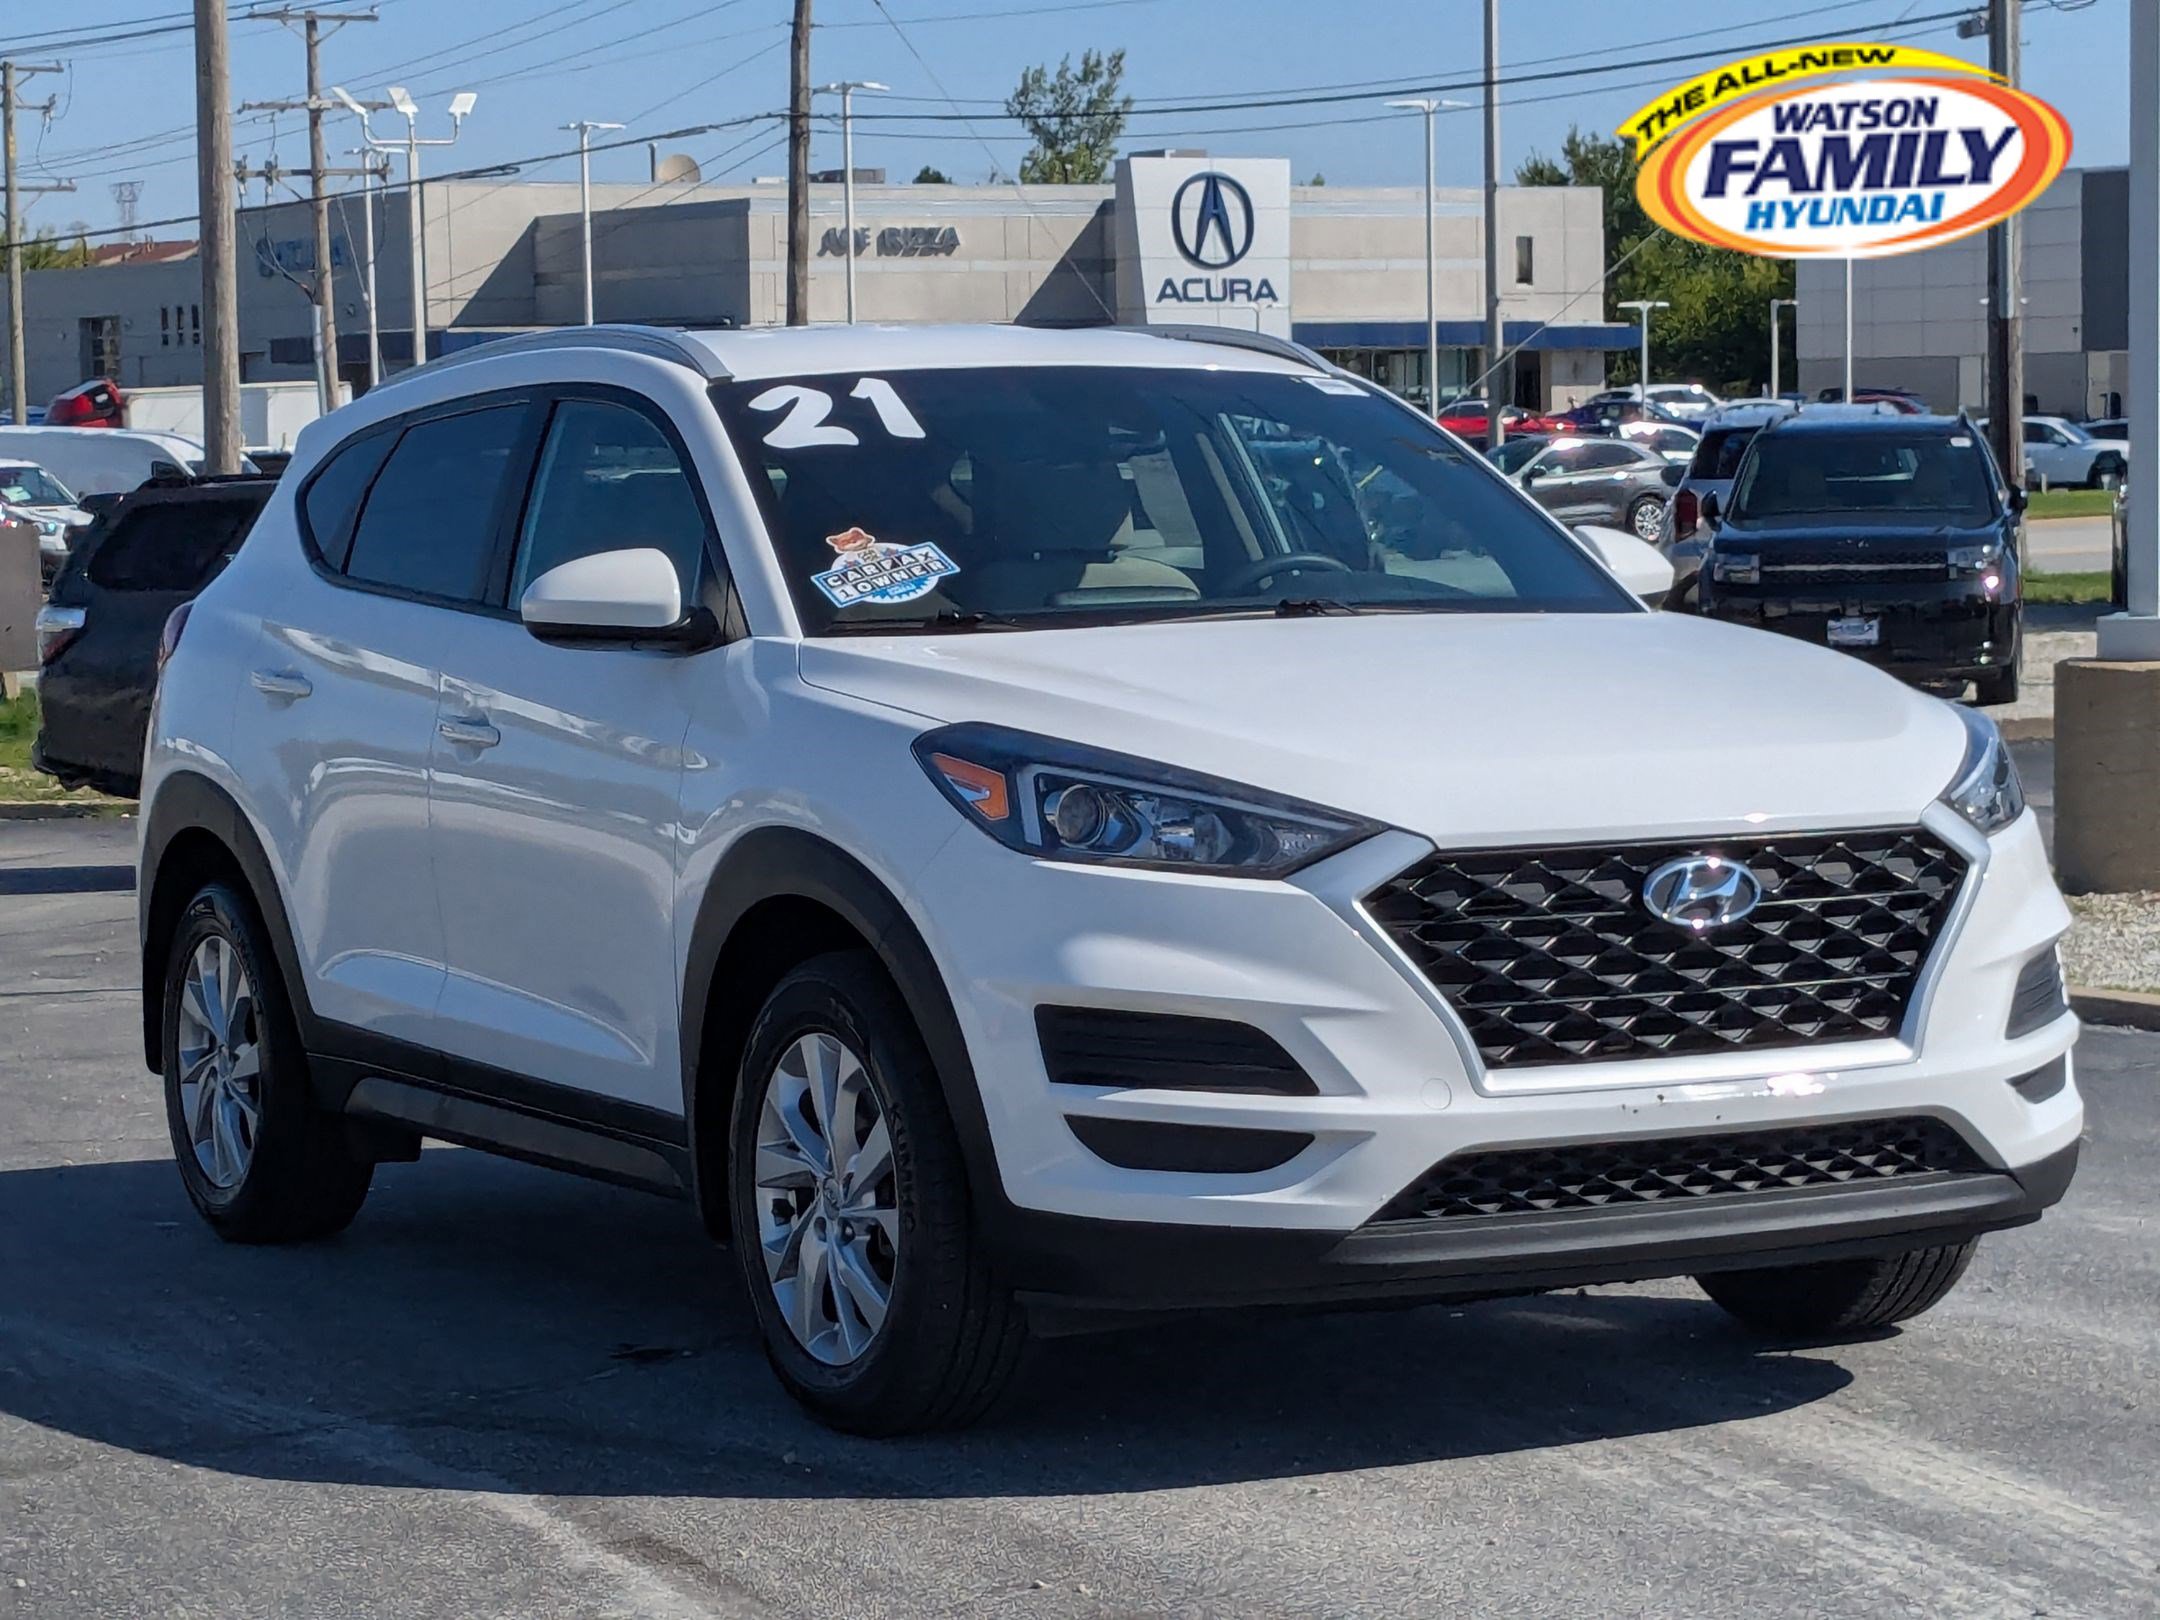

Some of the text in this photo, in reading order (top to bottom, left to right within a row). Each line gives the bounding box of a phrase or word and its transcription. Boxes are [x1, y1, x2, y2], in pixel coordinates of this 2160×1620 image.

[1156, 278, 1278, 302] ACURA
[748, 378, 926, 449] 21
[826, 551, 934, 587] CARFAX
[856, 561, 945, 593] OWNER
